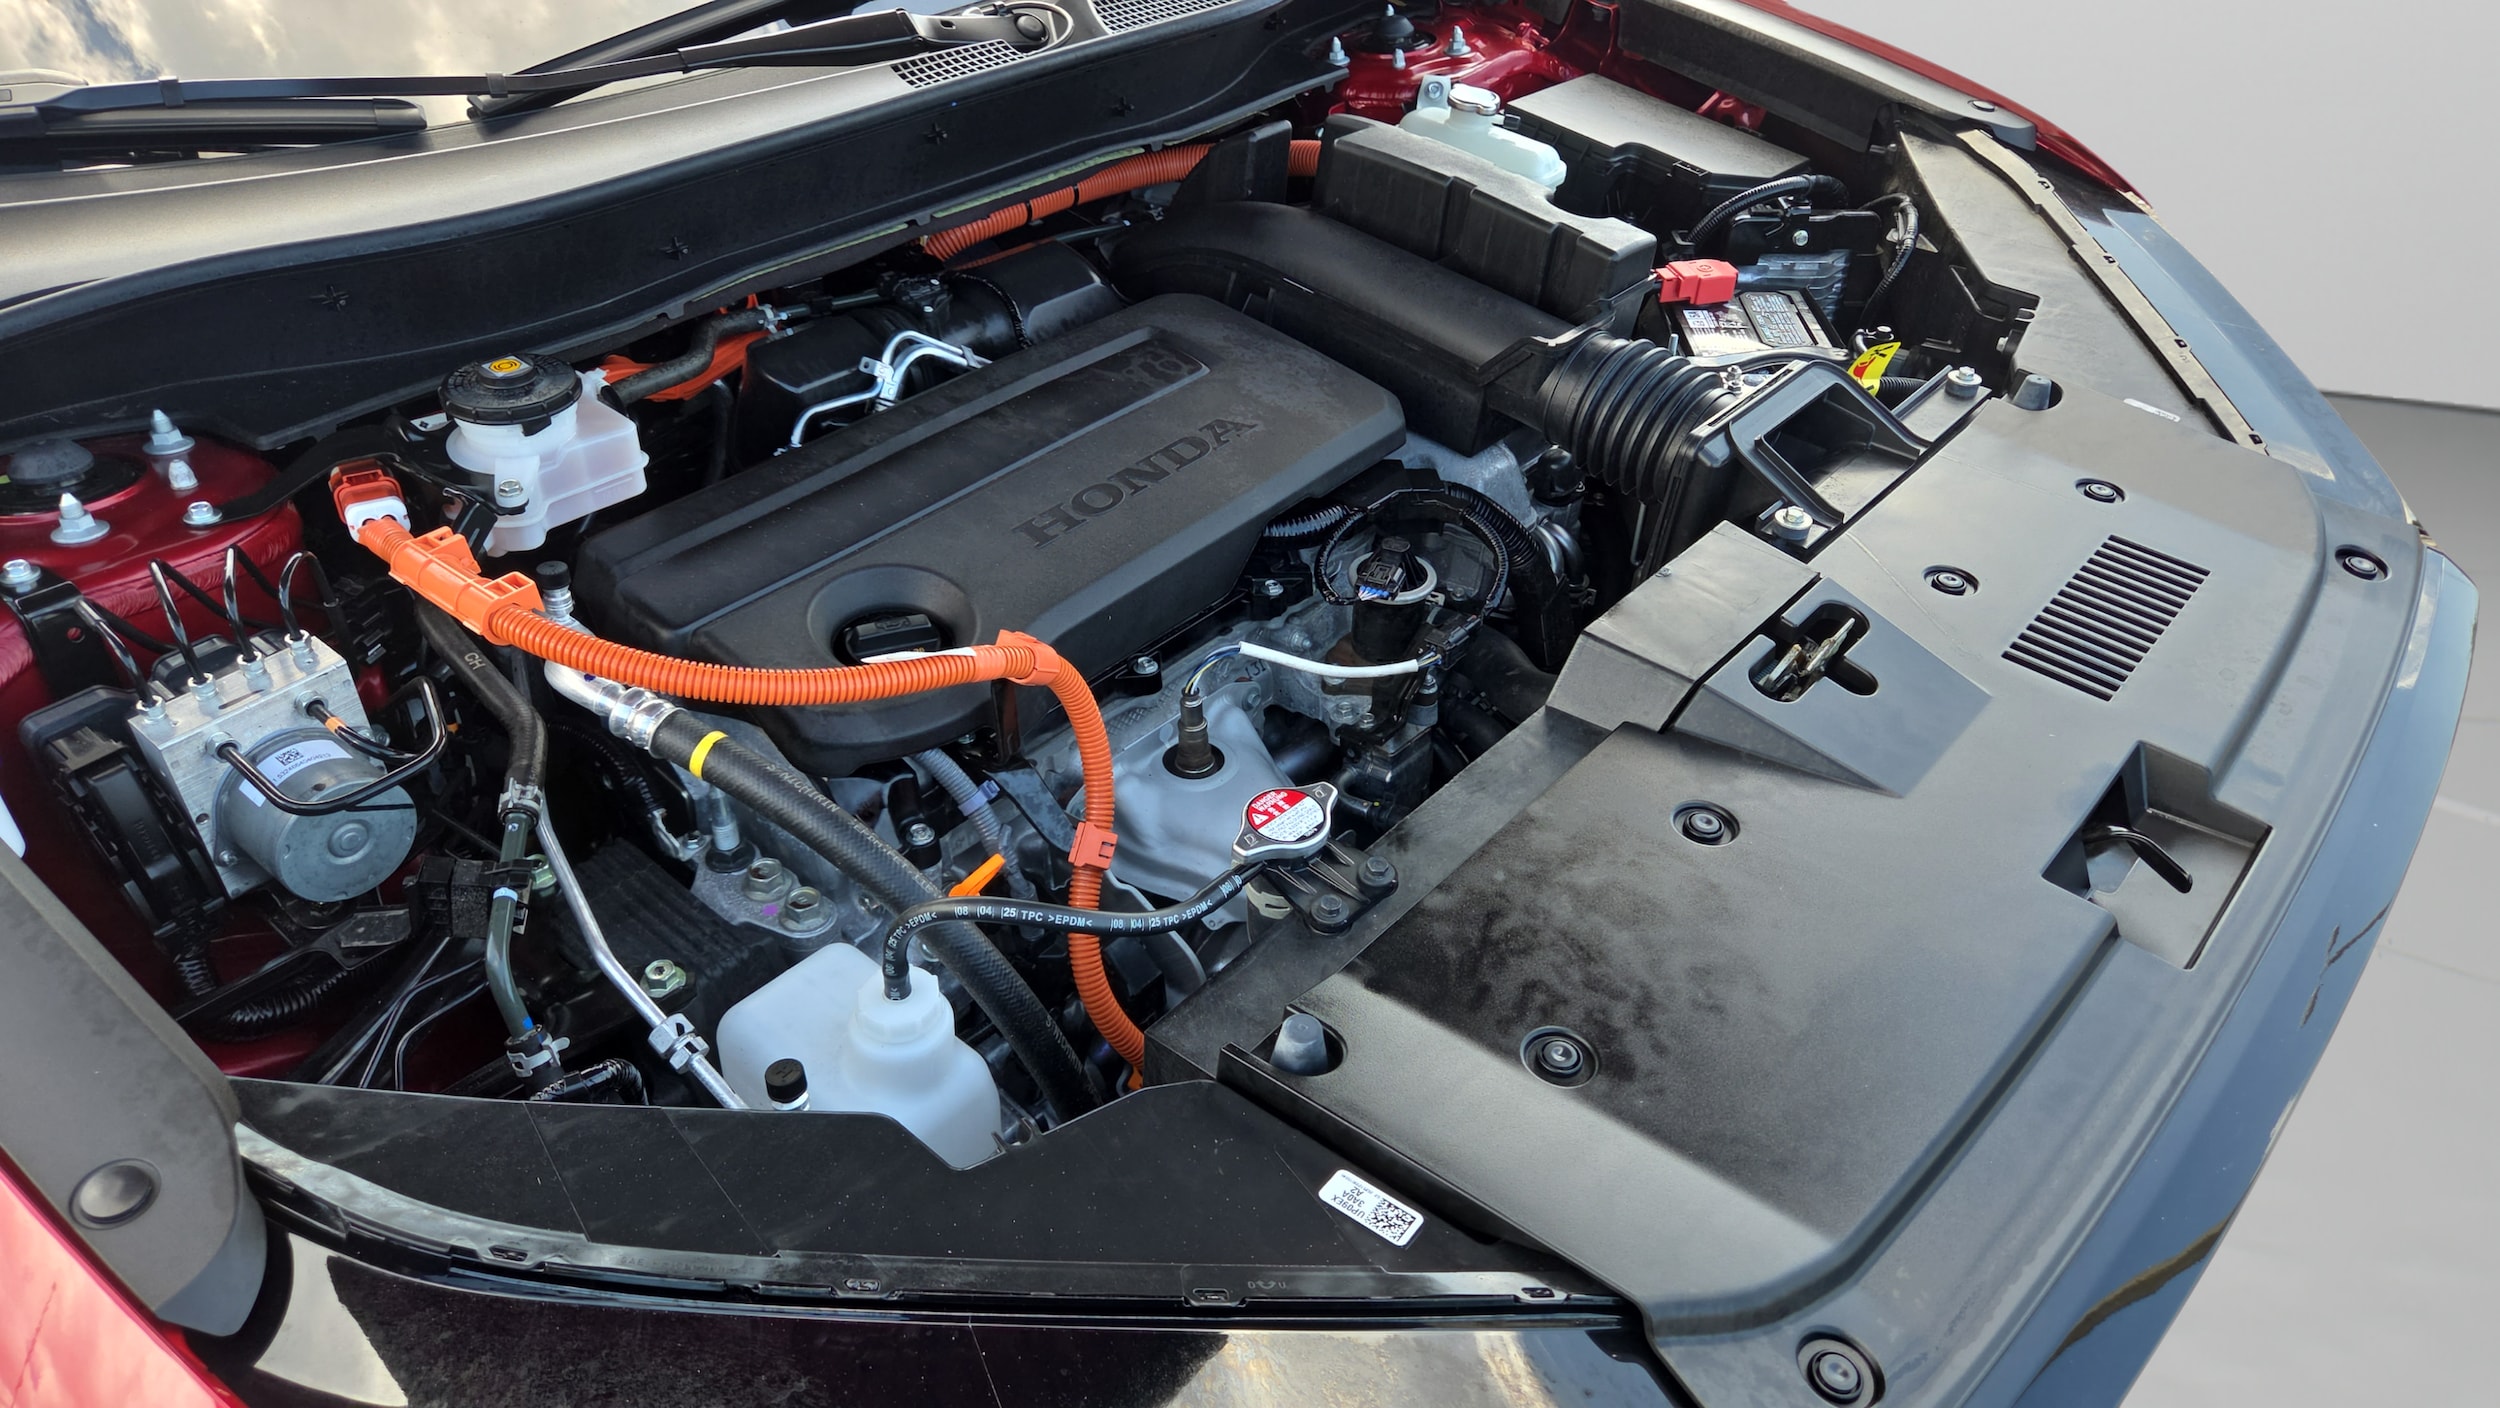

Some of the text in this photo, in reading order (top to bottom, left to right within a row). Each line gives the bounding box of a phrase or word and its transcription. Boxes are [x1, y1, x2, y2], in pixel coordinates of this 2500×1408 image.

[1011, 418, 1257, 548] HONDA
[464, 652, 486, 670] CH
[1021, 910, 1043, 922] TPC
[1163, 914, 1180, 927] TPC
[1350, 1186, 1365, 1197] A2
[1330, 1194, 1366, 1219] UP09EX
